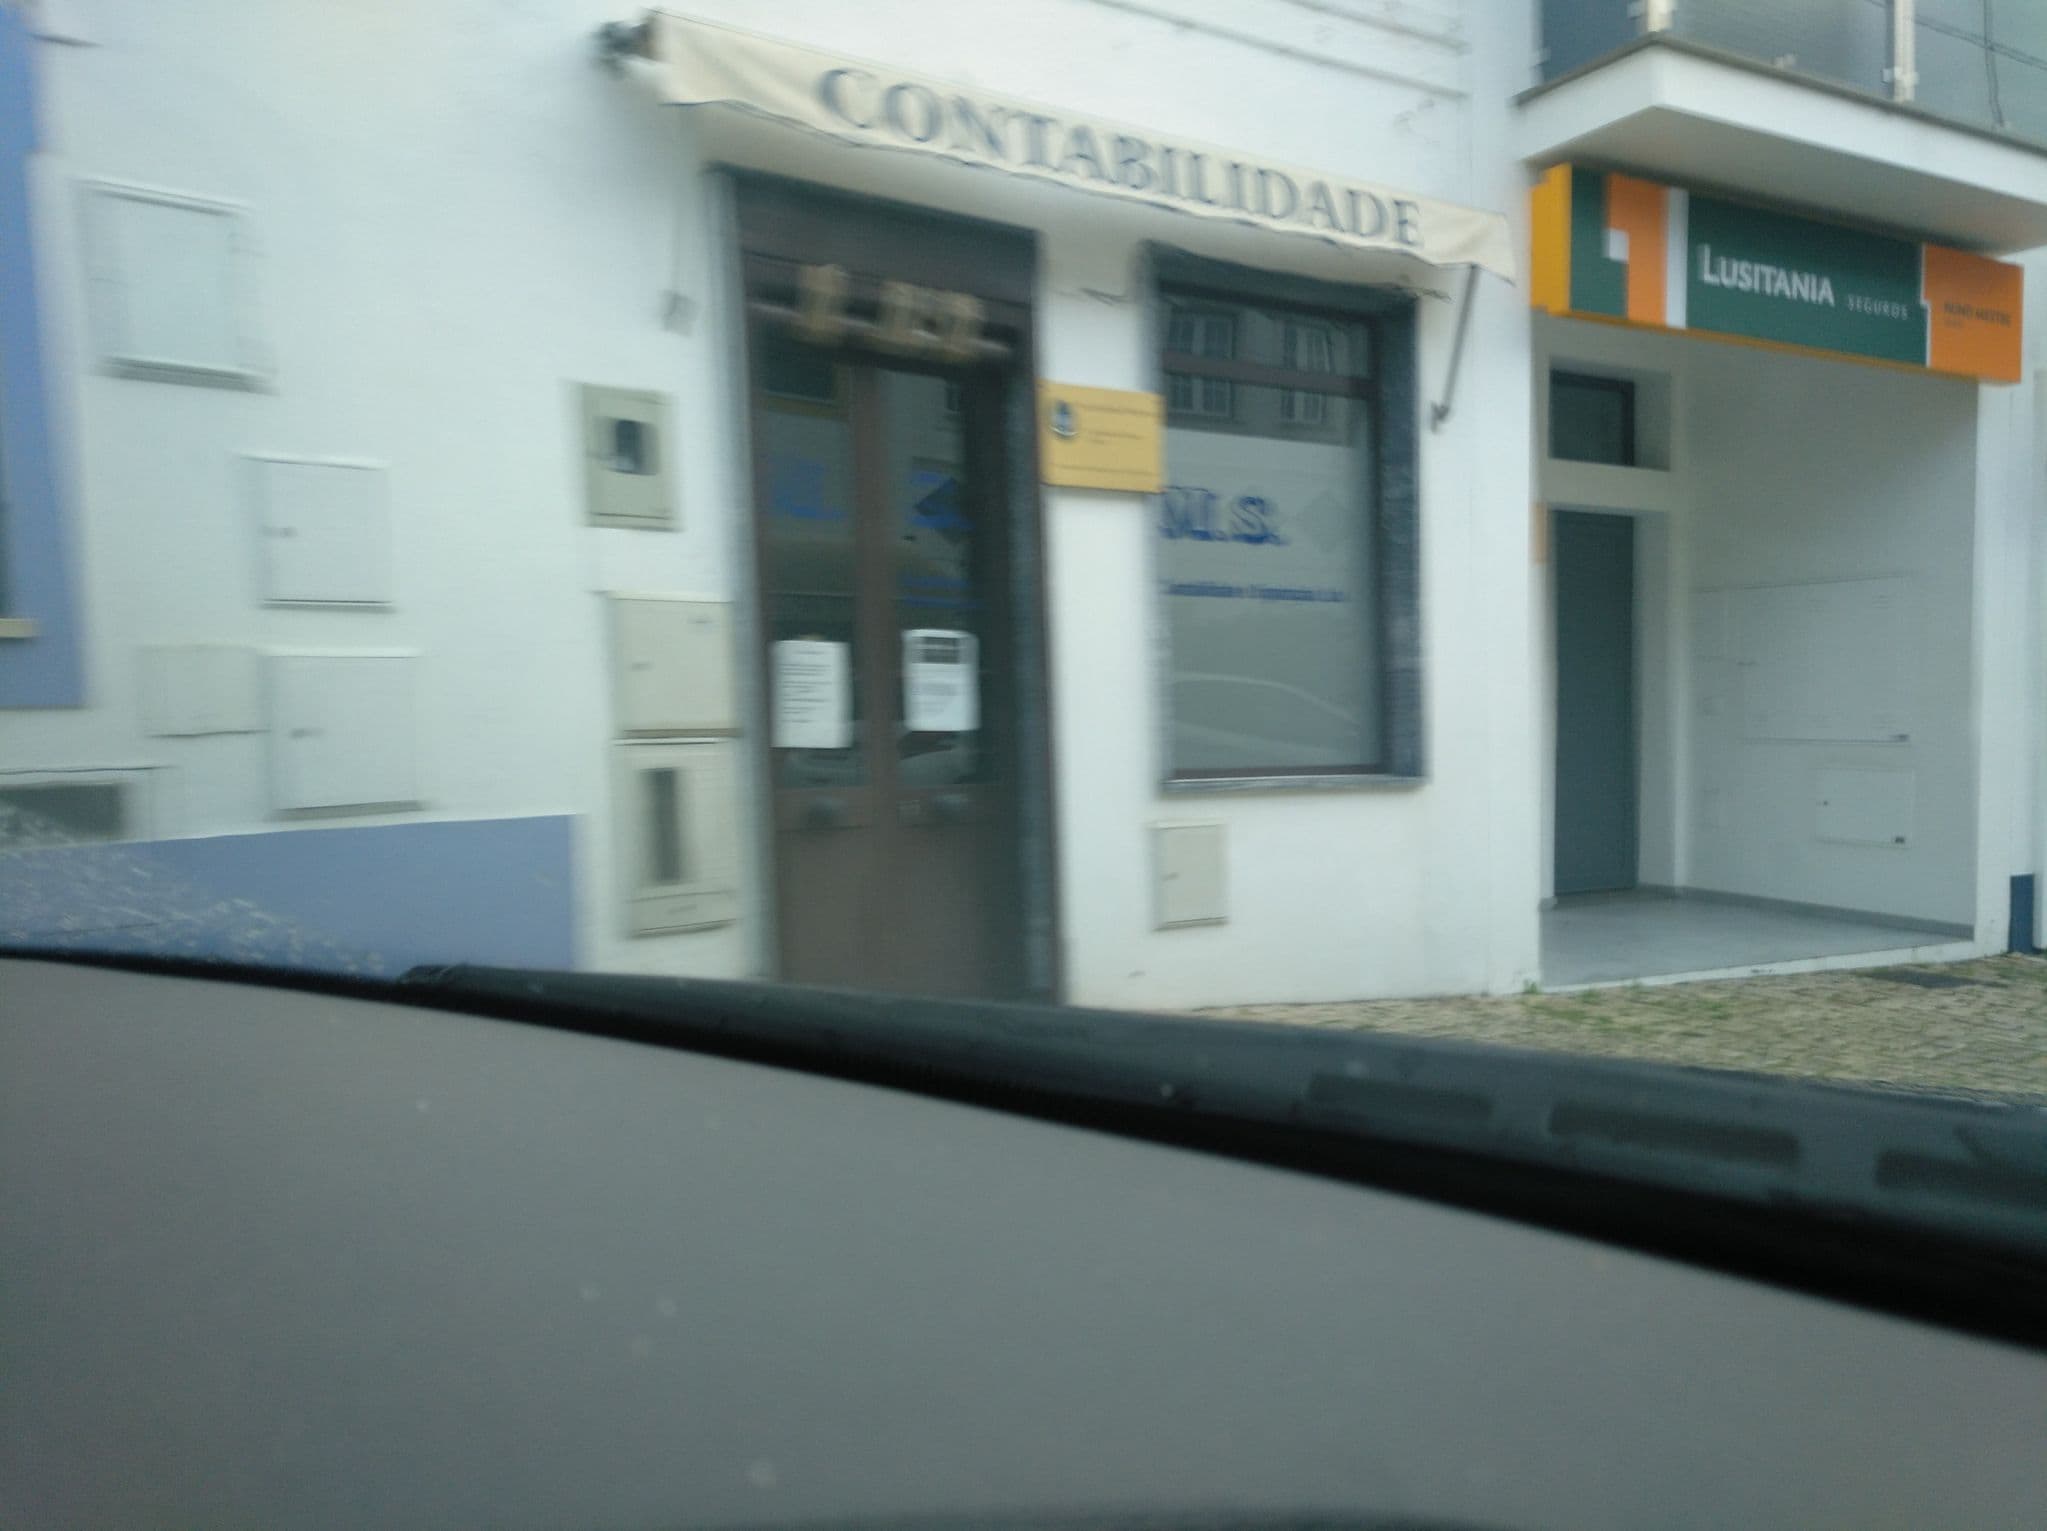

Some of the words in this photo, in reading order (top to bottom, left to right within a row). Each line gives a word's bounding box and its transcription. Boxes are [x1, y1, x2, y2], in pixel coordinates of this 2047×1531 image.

[815, 66, 1424, 248] CONTABILIDADE
[1698, 244, 1835, 307] LUSITANIA
[1847, 293, 1909, 321] SEGUROS
